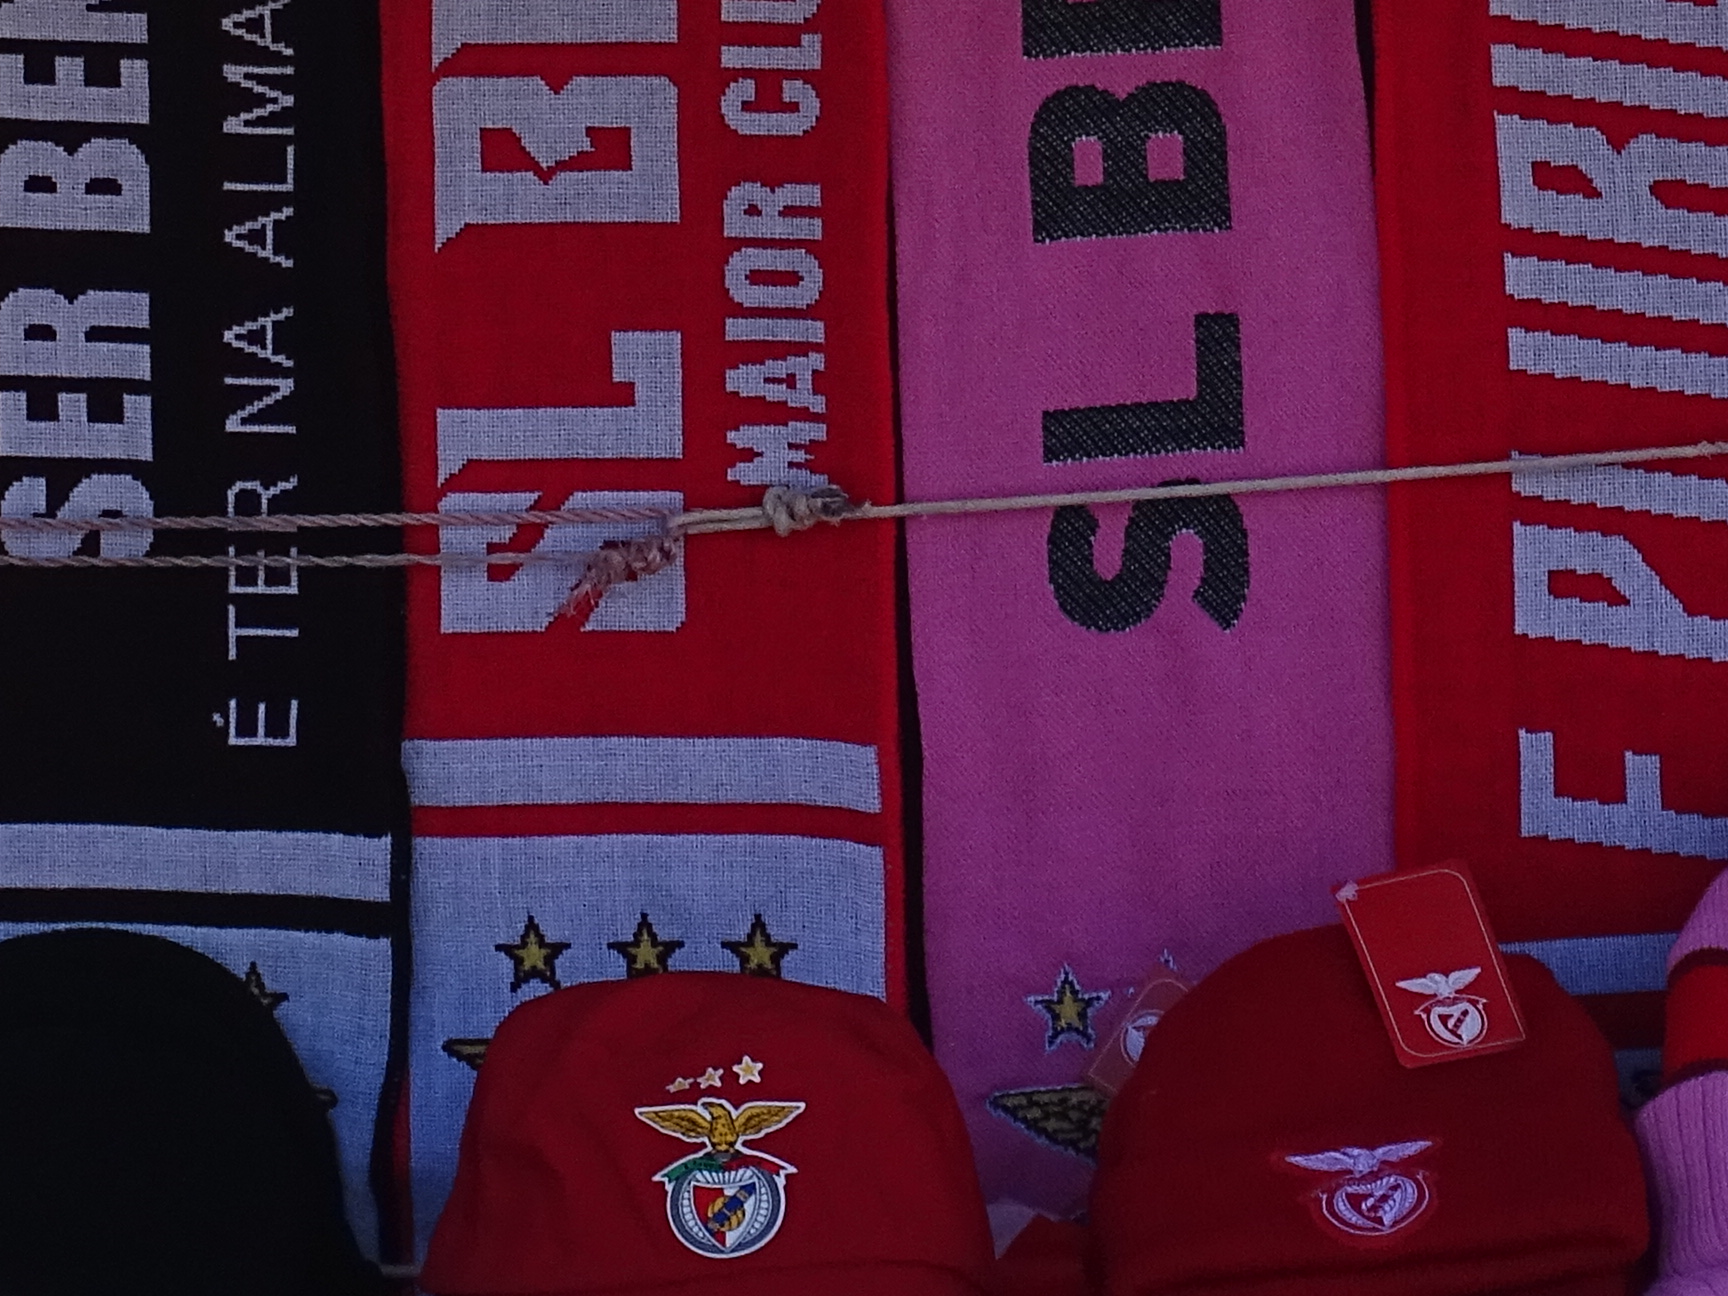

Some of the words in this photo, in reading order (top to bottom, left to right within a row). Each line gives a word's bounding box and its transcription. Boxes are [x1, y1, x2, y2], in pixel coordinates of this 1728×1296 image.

[224, 306, 298, 436] NA
[723, 181, 828, 490] MAIOR
[227, 473, 299, 661] TER
[436, 330, 687, 633] SL
[1041, 312, 1251, 633] SL
[213, 697, 299, 749] É
